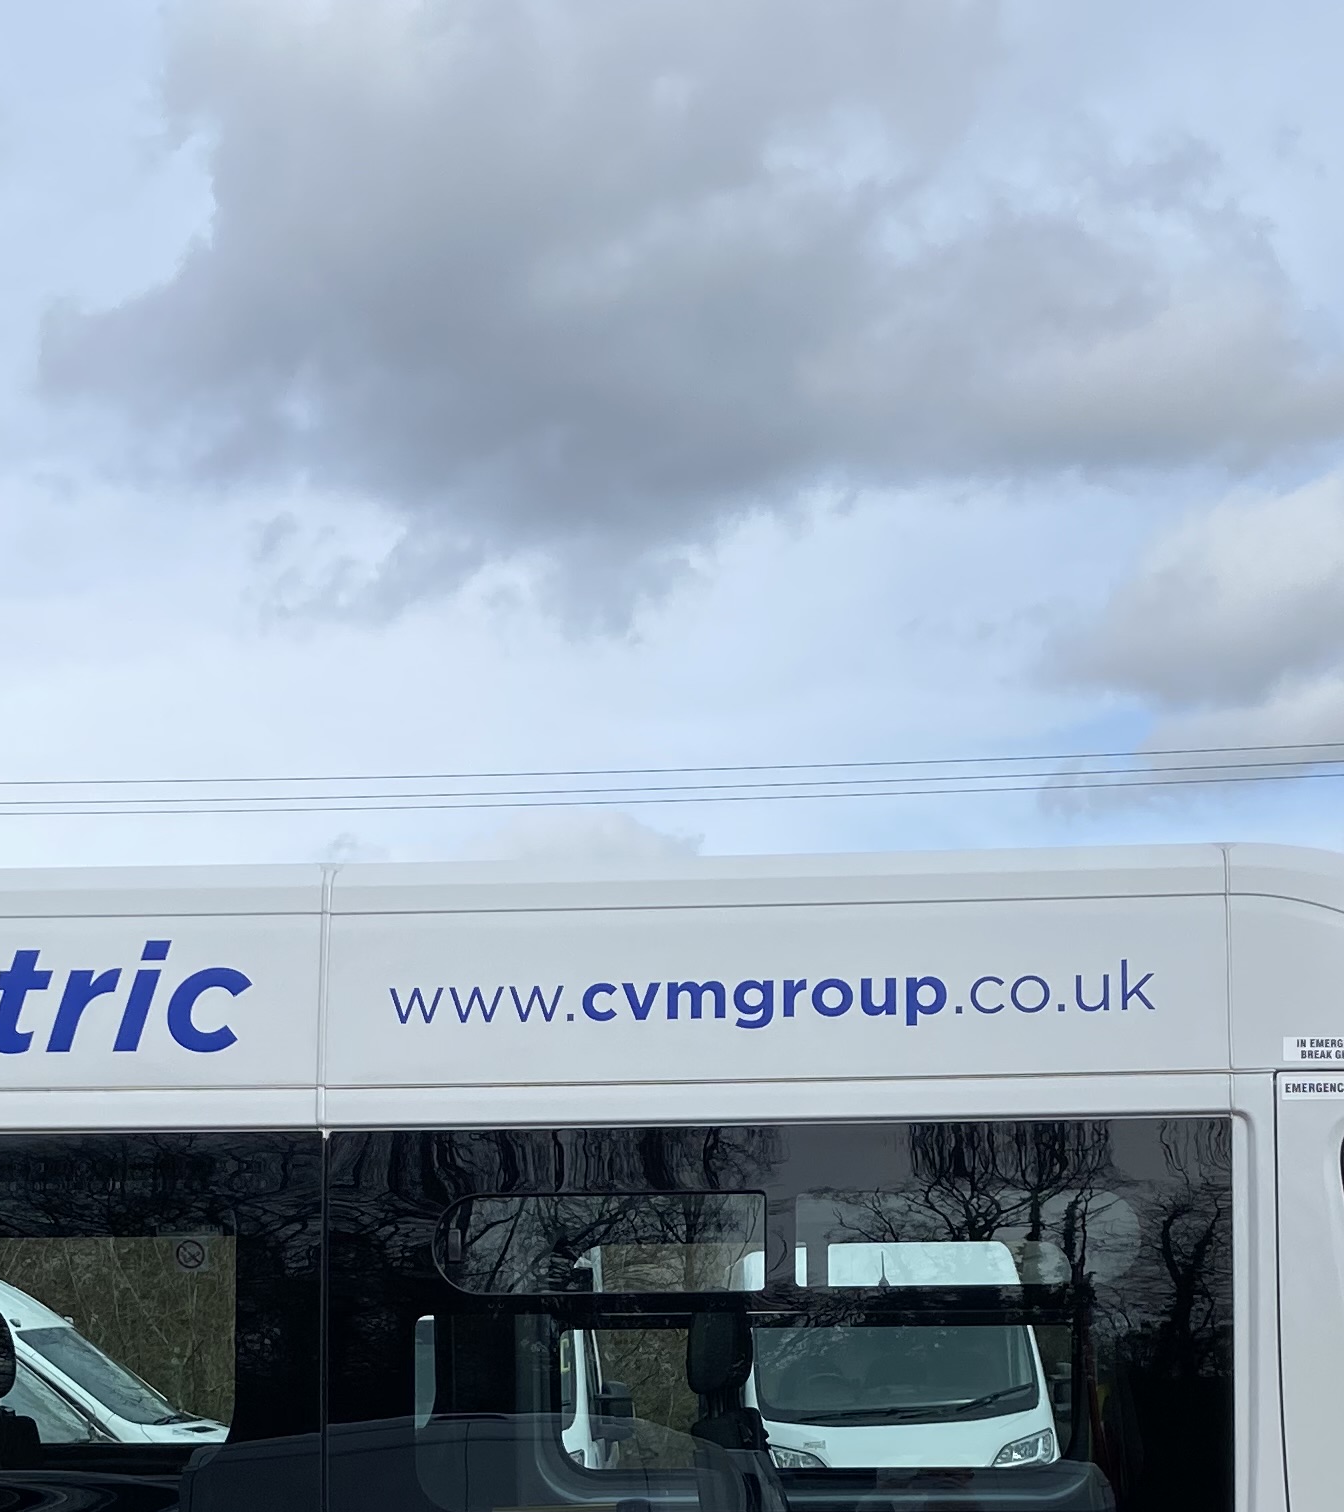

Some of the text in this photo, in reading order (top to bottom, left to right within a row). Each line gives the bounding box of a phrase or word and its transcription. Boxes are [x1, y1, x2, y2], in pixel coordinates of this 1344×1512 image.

[389, 959, 1154, 1030] www.cvmgroup.co.uk
[1296, 1038, 1307, 1048] IN
[1300, 1049, 1333, 1059] BREAK
